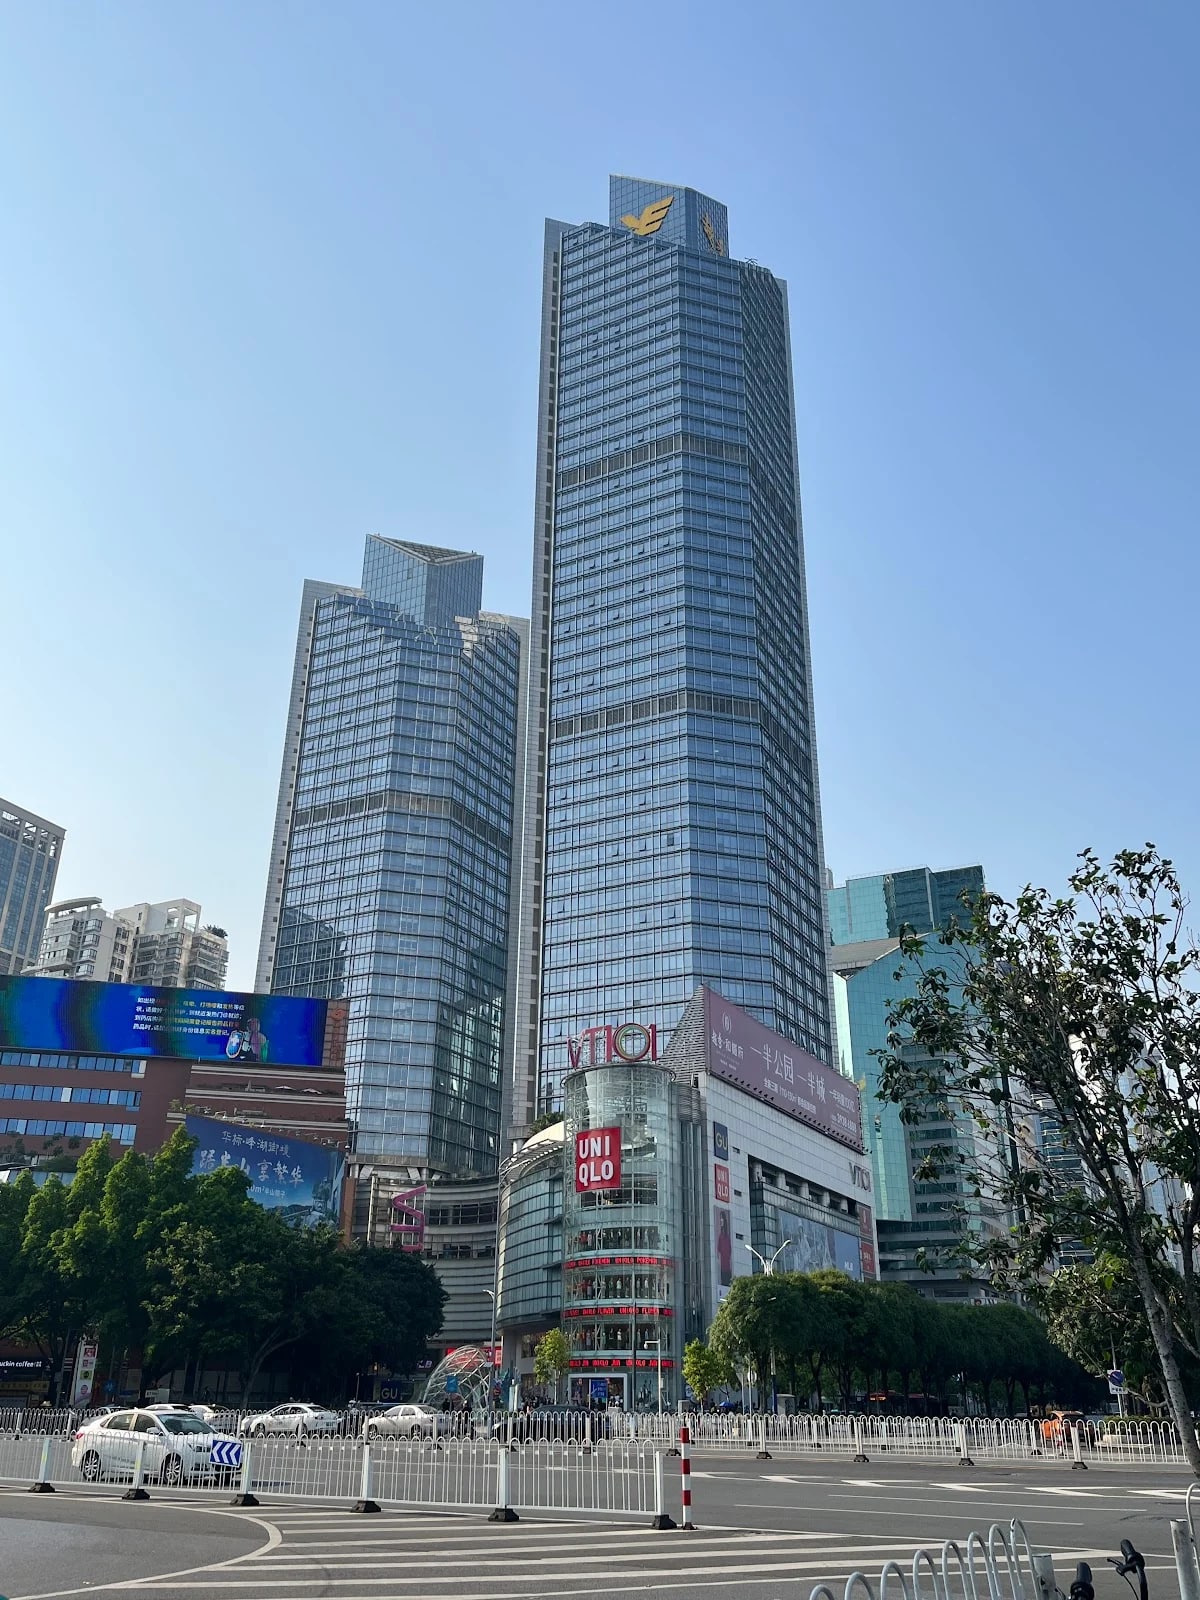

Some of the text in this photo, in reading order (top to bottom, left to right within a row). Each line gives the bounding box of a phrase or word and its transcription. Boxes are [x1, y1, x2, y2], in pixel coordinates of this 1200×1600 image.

[750, 1043, 794, 1085] 一半公园
[796, 1071, 826, 1104] 一半城
[579, 1136, 611, 1159] UNI
[716, 1133, 728, 1150] GU
[257, 1159, 305, 1188] 享繁华
[578, 1160, 614, 1187] QLO
[717, 1170, 728, 1184] UNI
[717, 1185, 729, 1198] QLO
[381, 1387, 399, 1400] GU
